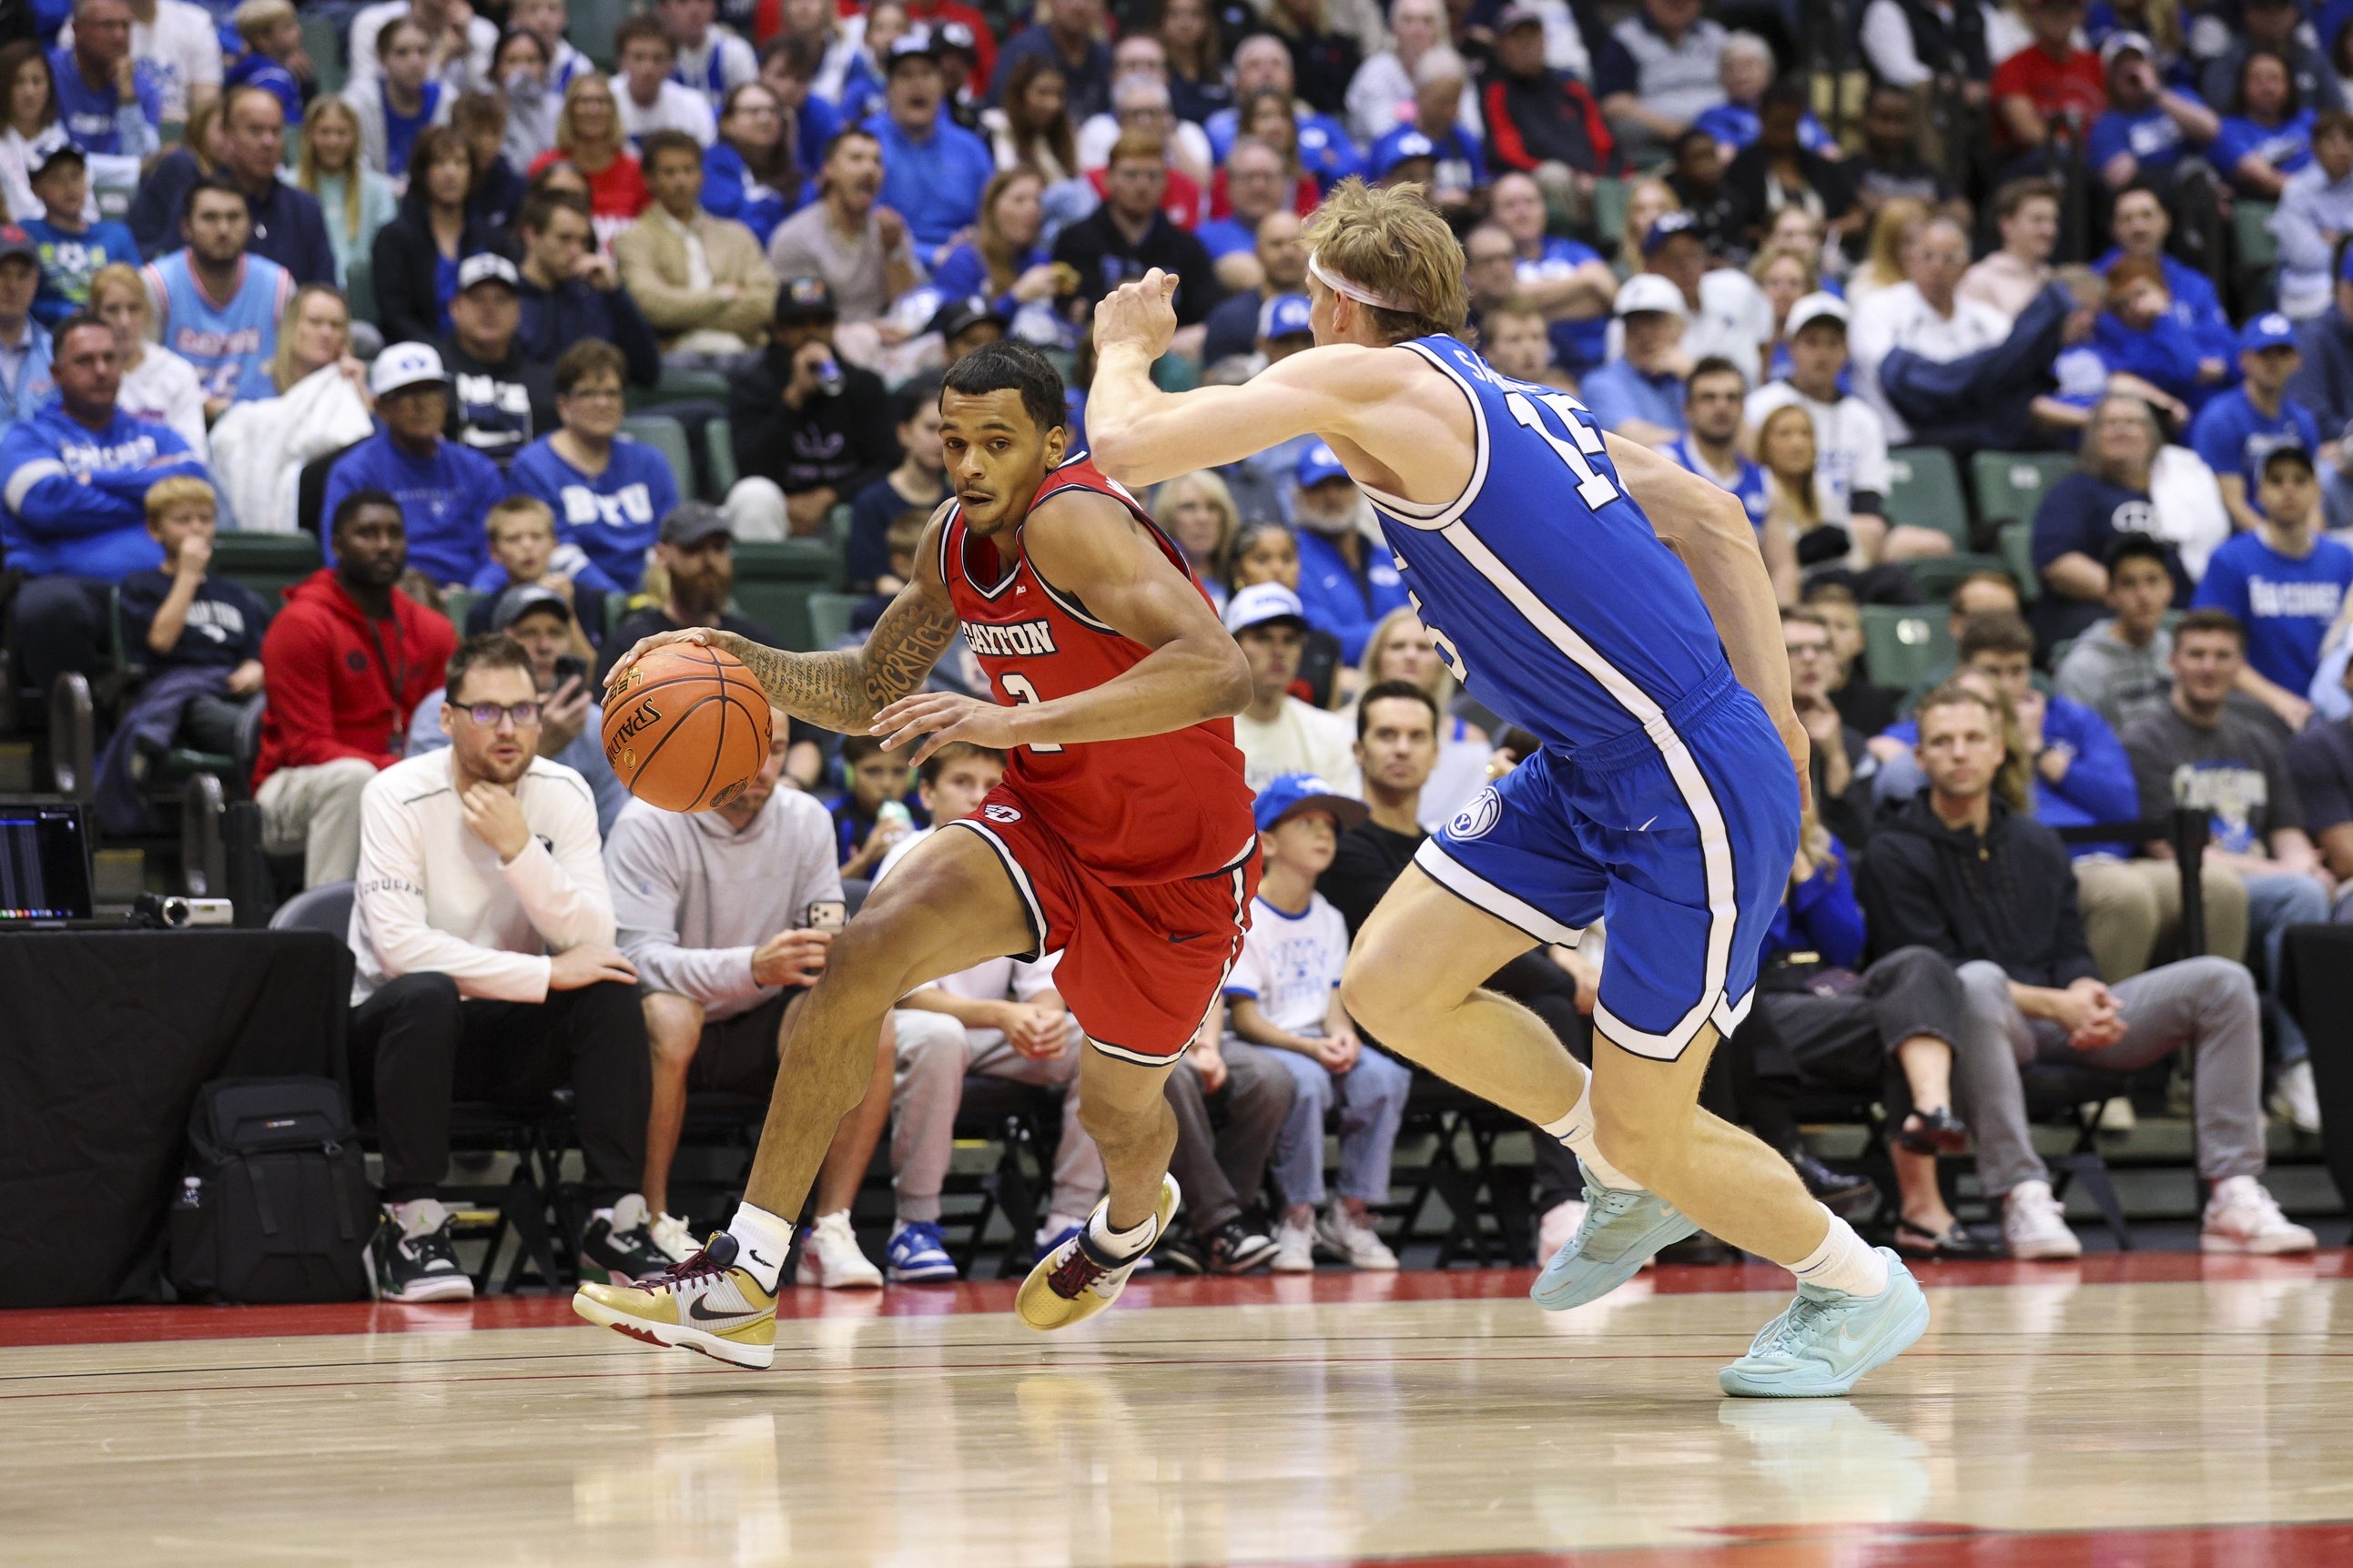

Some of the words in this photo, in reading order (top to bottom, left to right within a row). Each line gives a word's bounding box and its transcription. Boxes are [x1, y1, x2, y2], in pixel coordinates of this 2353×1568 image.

[1504, 392, 1620, 511] 15
[806, 656, 817, 688] Faith
[815, 660, 827, 696] Have
[866, 612, 956, 708] SACRIFICE
[805, 688, 814, 702] in
